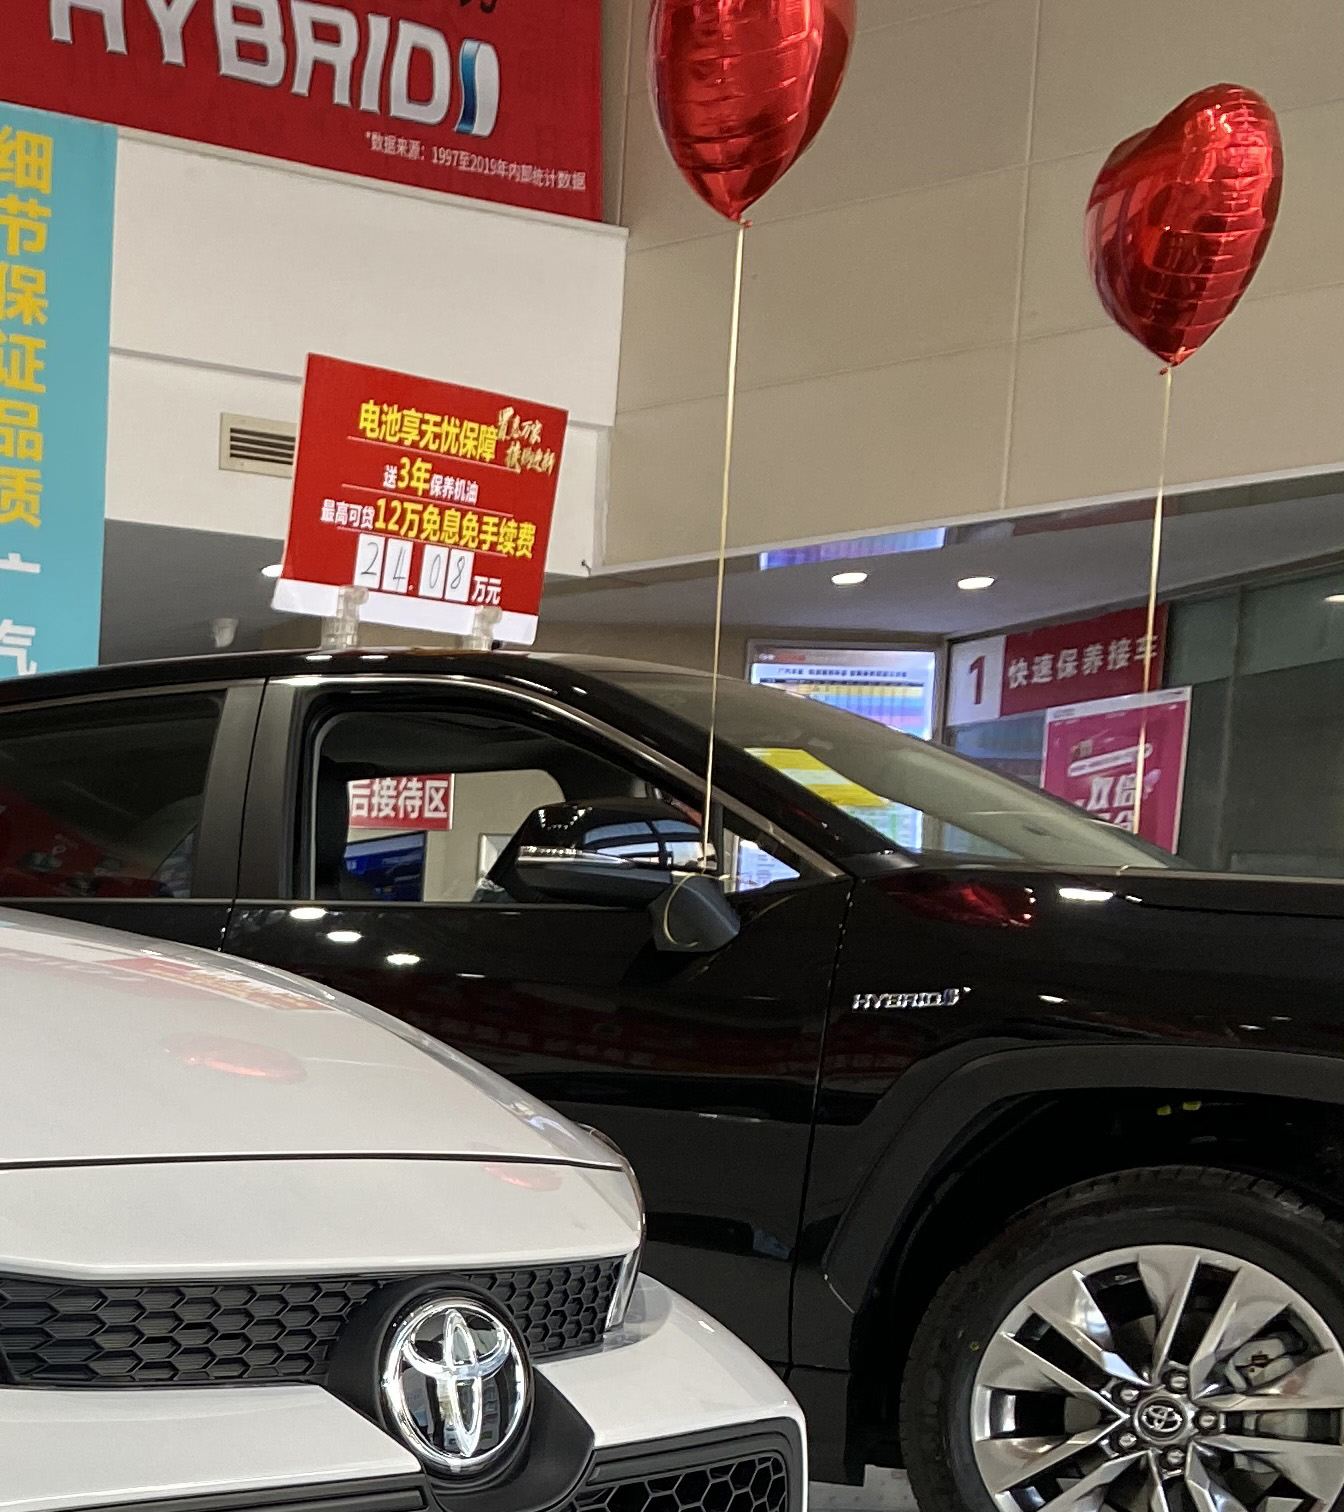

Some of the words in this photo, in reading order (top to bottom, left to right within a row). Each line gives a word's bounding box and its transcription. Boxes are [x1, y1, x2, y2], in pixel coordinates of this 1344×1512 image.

[359, 399, 498, 462] 电池享无忧保障
[968, 655, 986, 704] 1
[1007, 634, 1159, 690] 快速保养接车
[851, 992, 943, 1010] HYBRID
